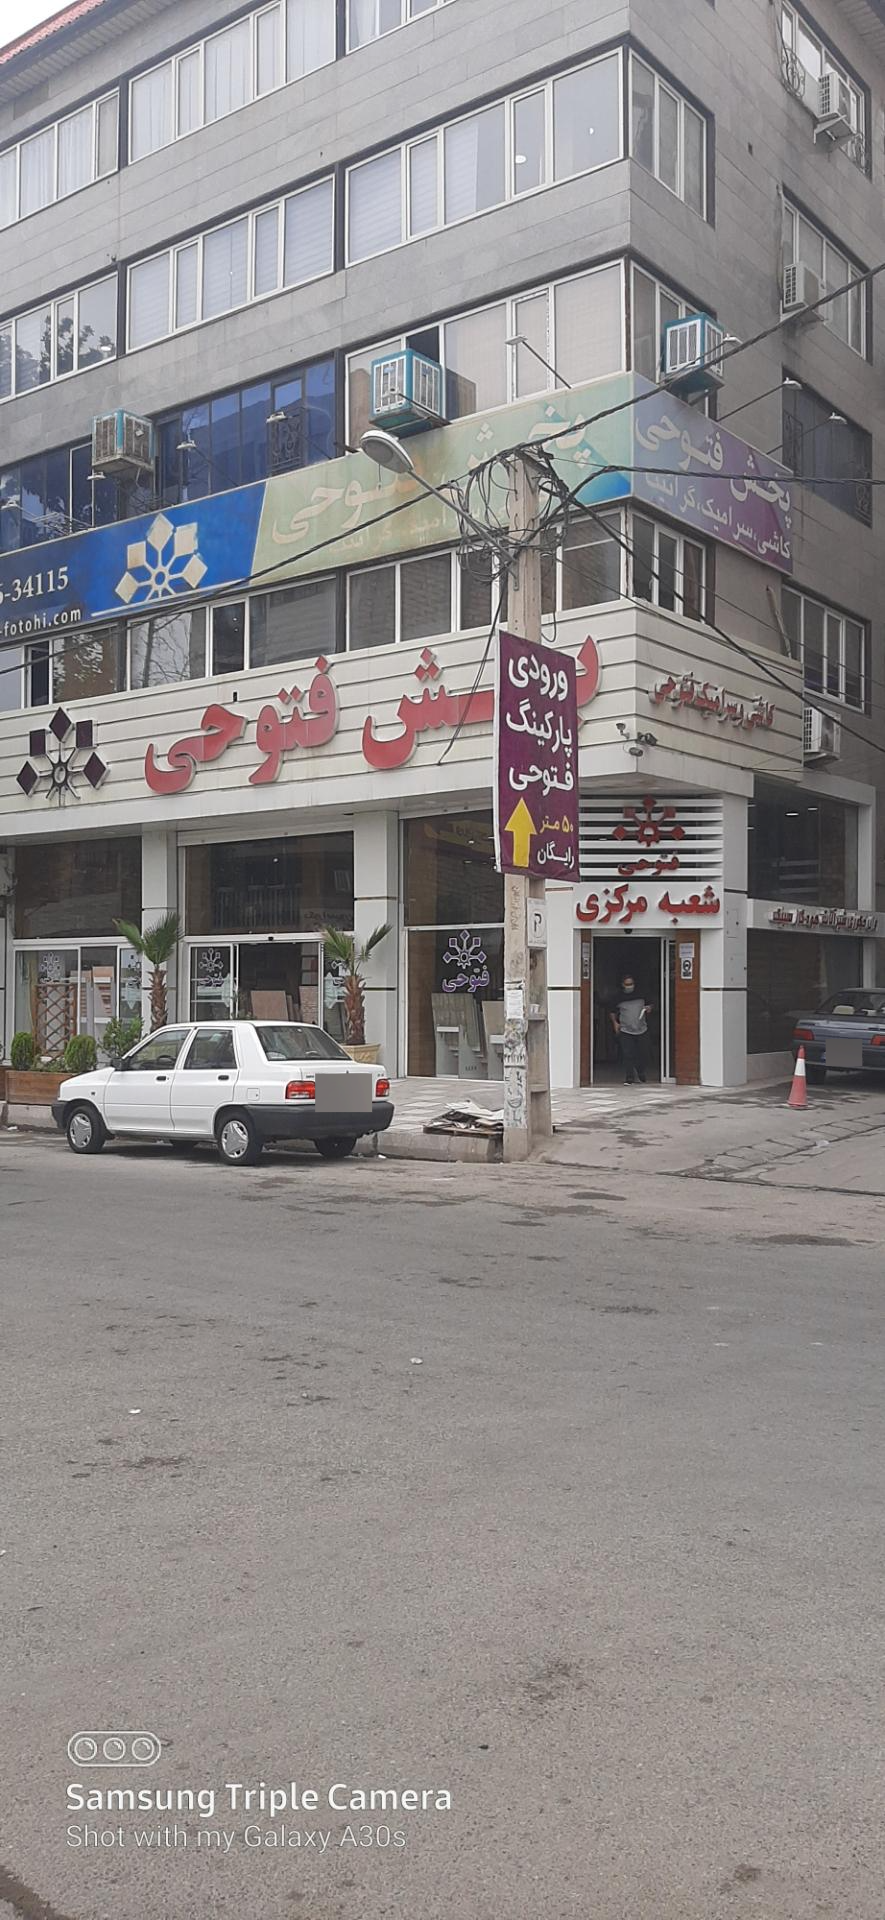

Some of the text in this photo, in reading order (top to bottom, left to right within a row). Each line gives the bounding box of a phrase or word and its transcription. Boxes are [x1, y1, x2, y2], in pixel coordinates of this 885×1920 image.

[635, 414, 792, 529] پخش فتوحی
[508, 653, 569, 701] ورودی
[144, 654, 340, 795] فتوحی
[505, 698, 573, 757] پارکینگ
[508, 761, 574, 796] فتوحی
[539, 816, 560, 834] متر
[536, 840, 575, 869] رایگان
[617, 850, 680, 876] فتوحی
[575, 883, 721, 925] شعبه مرکزی
[441, 965, 490, 993] فتوحی
